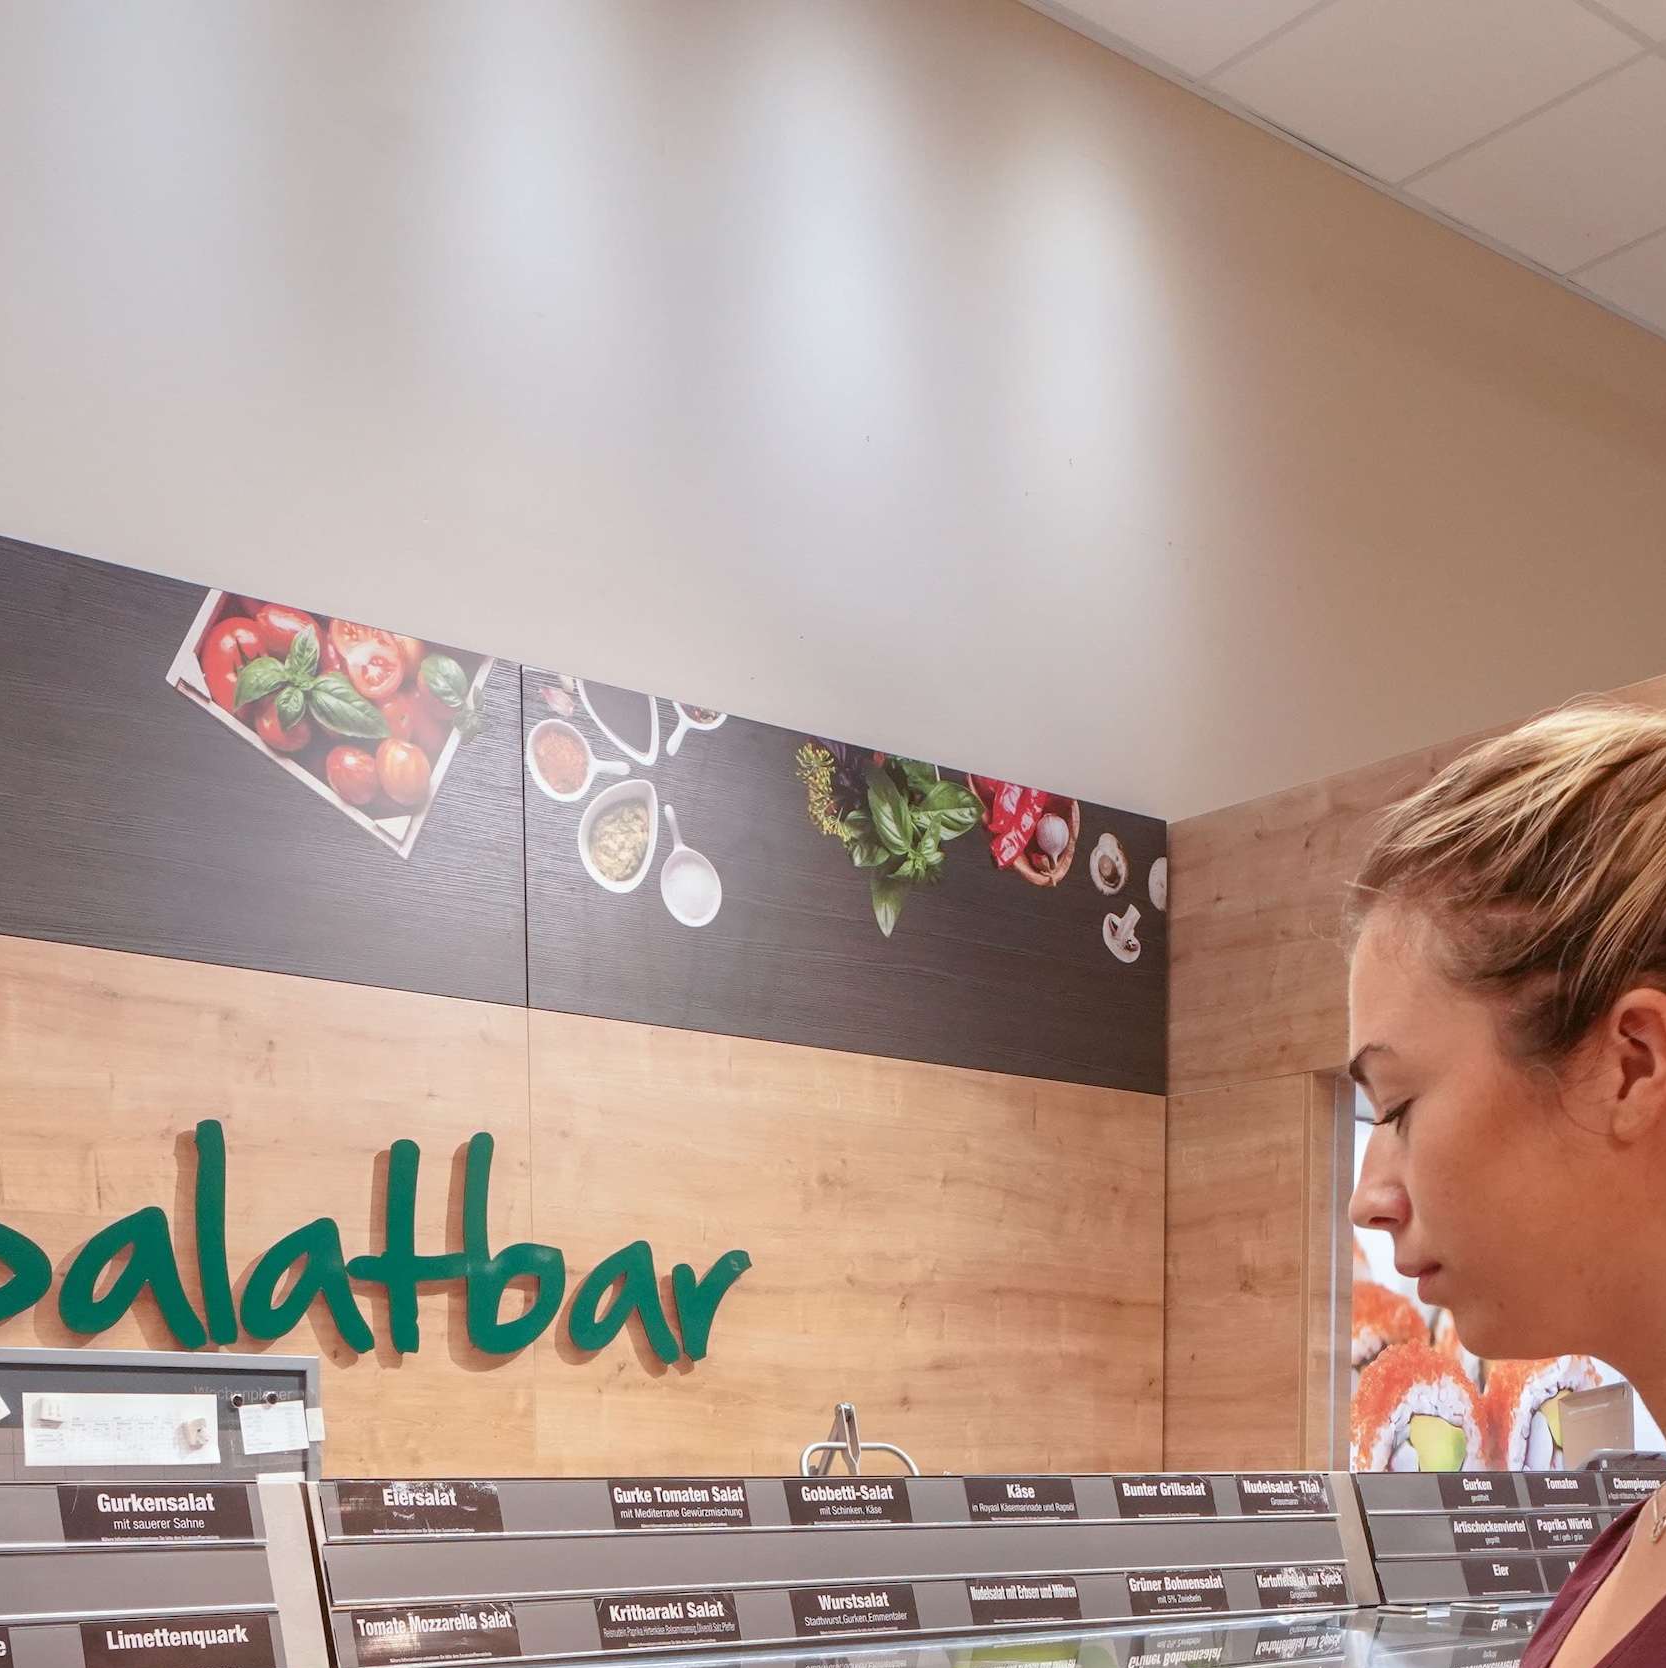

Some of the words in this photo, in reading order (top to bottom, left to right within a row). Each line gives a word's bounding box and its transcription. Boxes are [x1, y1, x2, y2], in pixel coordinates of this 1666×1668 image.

[1122, 1483, 1157, 1496] Bunter
[1159, 1482, 1206, 1496] Grillsalat
[1299, 1481, 1319, 1493] Thai
[1463, 1478, 1492, 1491] Gurken
[1544, 1478, 1578, 1489] Tomaten
[1613, 1478, 1661, 1491] Champignons
[383, 1488, 457, 1506] Eiersalat
[613, 1486, 652, 1503] Gurke
[653, 1486, 709, 1502] Tomaten
[712, 1486, 744, 1502] Salat
[801, 1485, 894, 1501] Gobbetti-Salat
[1006, 1484, 1035, 1498] Käse
[97, 1493, 215, 1513] Gurkensalat
[819, 1506, 830, 1515] mit
[832, 1505, 864, 1515] Schinken,
[865, 1504, 882, 1514] Käse
[972, 1504, 978, 1512] in
[1043, 1503, 1053, 1511] und
[620, 1508, 633, 1518] mit
[634, 1507, 679, 1518] Mediterrane
[681, 1507, 743, 1519] Gewürzmischung
[113, 1518, 131, 1530] mit
[133, 1519, 171, 1530] sauerer
[173, 1517, 205, 1529] Sahne
[1453, 1520, 1527, 1533] Artischockenviertel
[1536, 1518, 1567, 1533] Paprika
[1567, 1518, 1593, 1530] Würfel
[1492, 1564, 1509, 1576] Eier
[1129, 1577, 1162, 1592] Grüner
[1164, 1575, 1223, 1590] Bohnensalat
[1307, 1574, 1320, 1586] mit
[1321, 1573, 1343, 1587] Speck
[970, 1586, 1006, 1600] Nudelsalat
[817, 1592, 889, 1610] Wurstsalat
[609, 1603, 683, 1622] Kritharaki
[686, 1601, 724, 1618] Salat
[357, 1617, 406, 1636] Tomate
[408, 1613, 477, 1633] Mozzarella
[479, 1611, 512, 1629] Salat
[106, 1624, 249, 1650] Limettenquark
